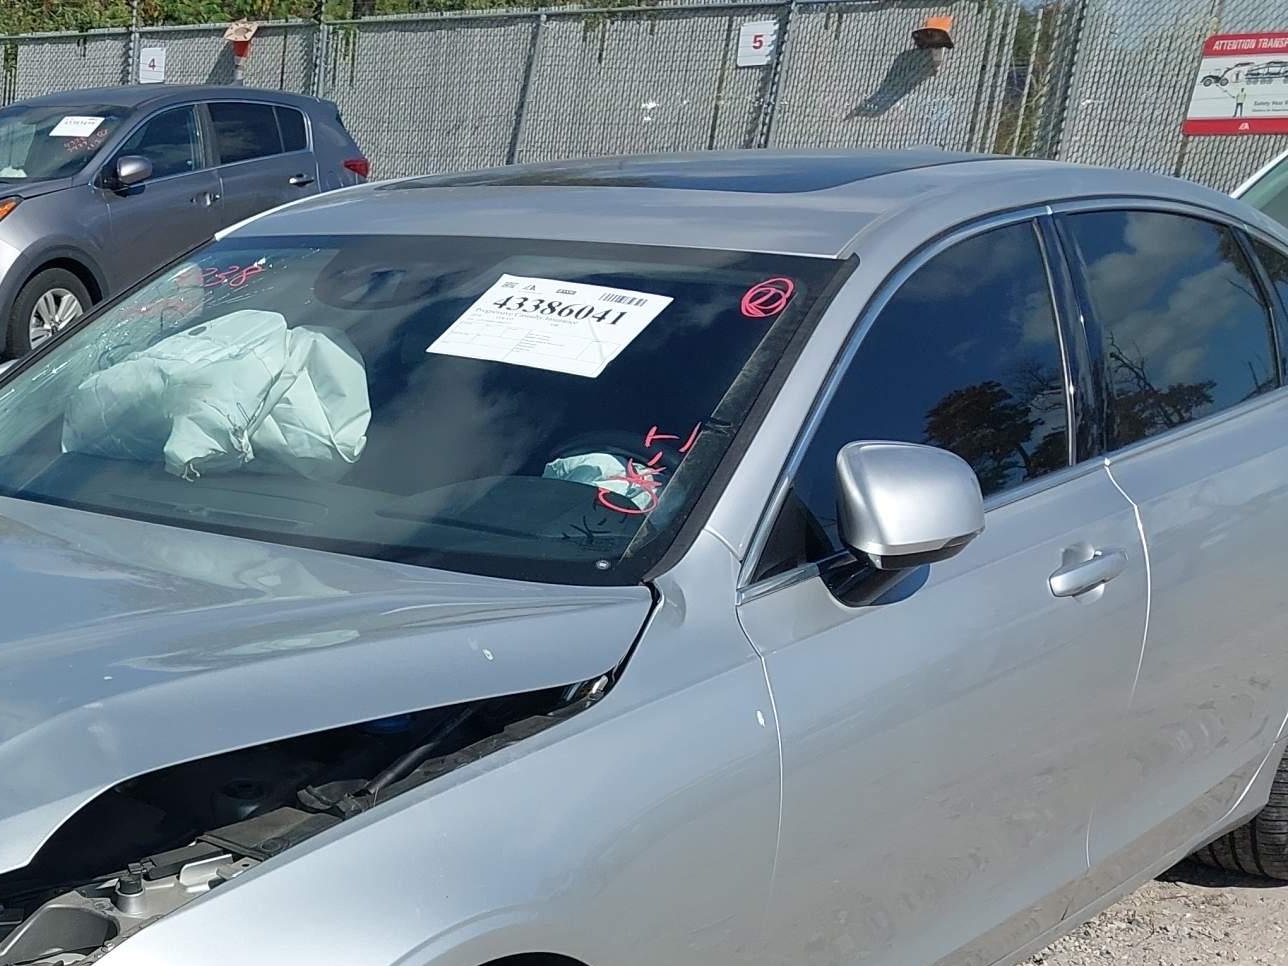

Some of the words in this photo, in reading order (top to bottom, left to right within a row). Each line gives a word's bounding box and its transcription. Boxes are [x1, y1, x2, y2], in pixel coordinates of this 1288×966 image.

[752, 34, 764, 50] 5
[1212, 39, 1257, 50] ATTENTION
[148, 58, 157, 71] 4
[493, 295, 628, 325] 43386041
